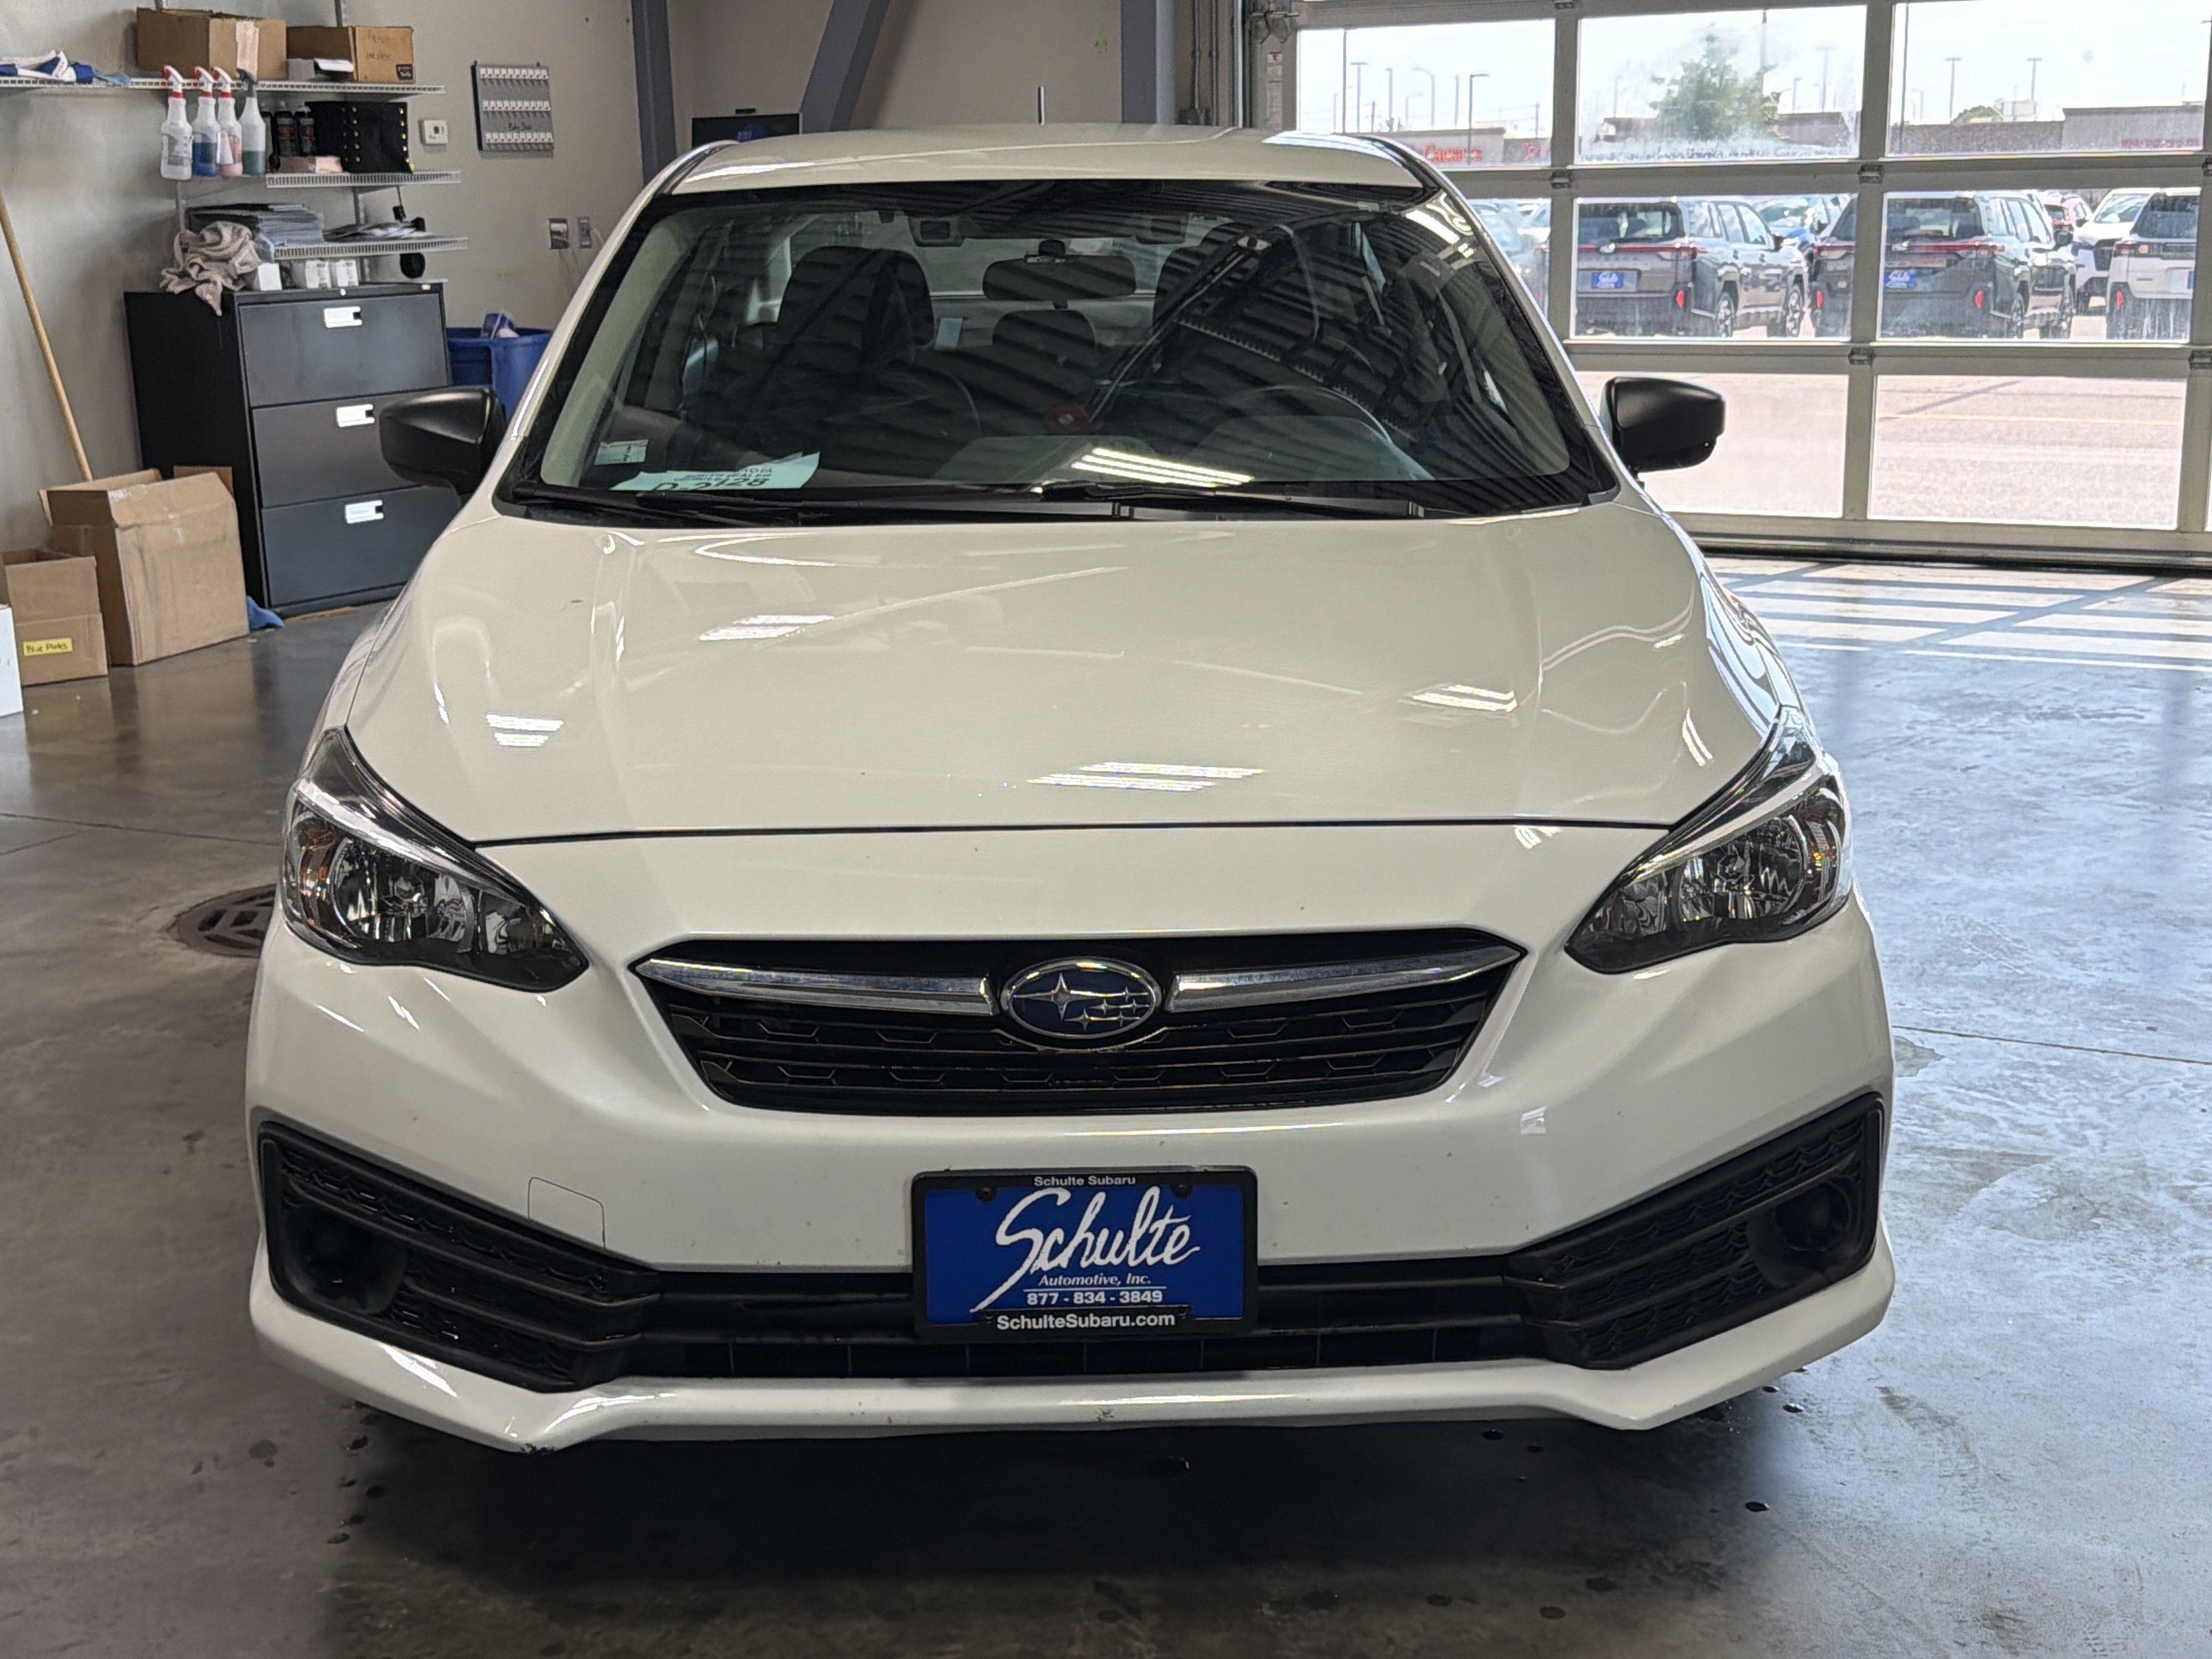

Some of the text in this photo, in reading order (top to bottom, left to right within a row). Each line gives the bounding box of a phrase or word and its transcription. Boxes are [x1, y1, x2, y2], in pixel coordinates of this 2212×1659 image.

[1034, 1175, 1136, 1187] Schulte Subaru
[969, 1186, 1201, 1313] Schulte
[1038, 1272, 1152, 1286] Automotive, Inc.
[1026, 1293, 1059, 1306] 877
[1073, 1291, 1106, 1304] 834
[1119, 1290, 1163, 1304] 3849
[996, 1313, 1176, 1330] SchulteSubaru.com
